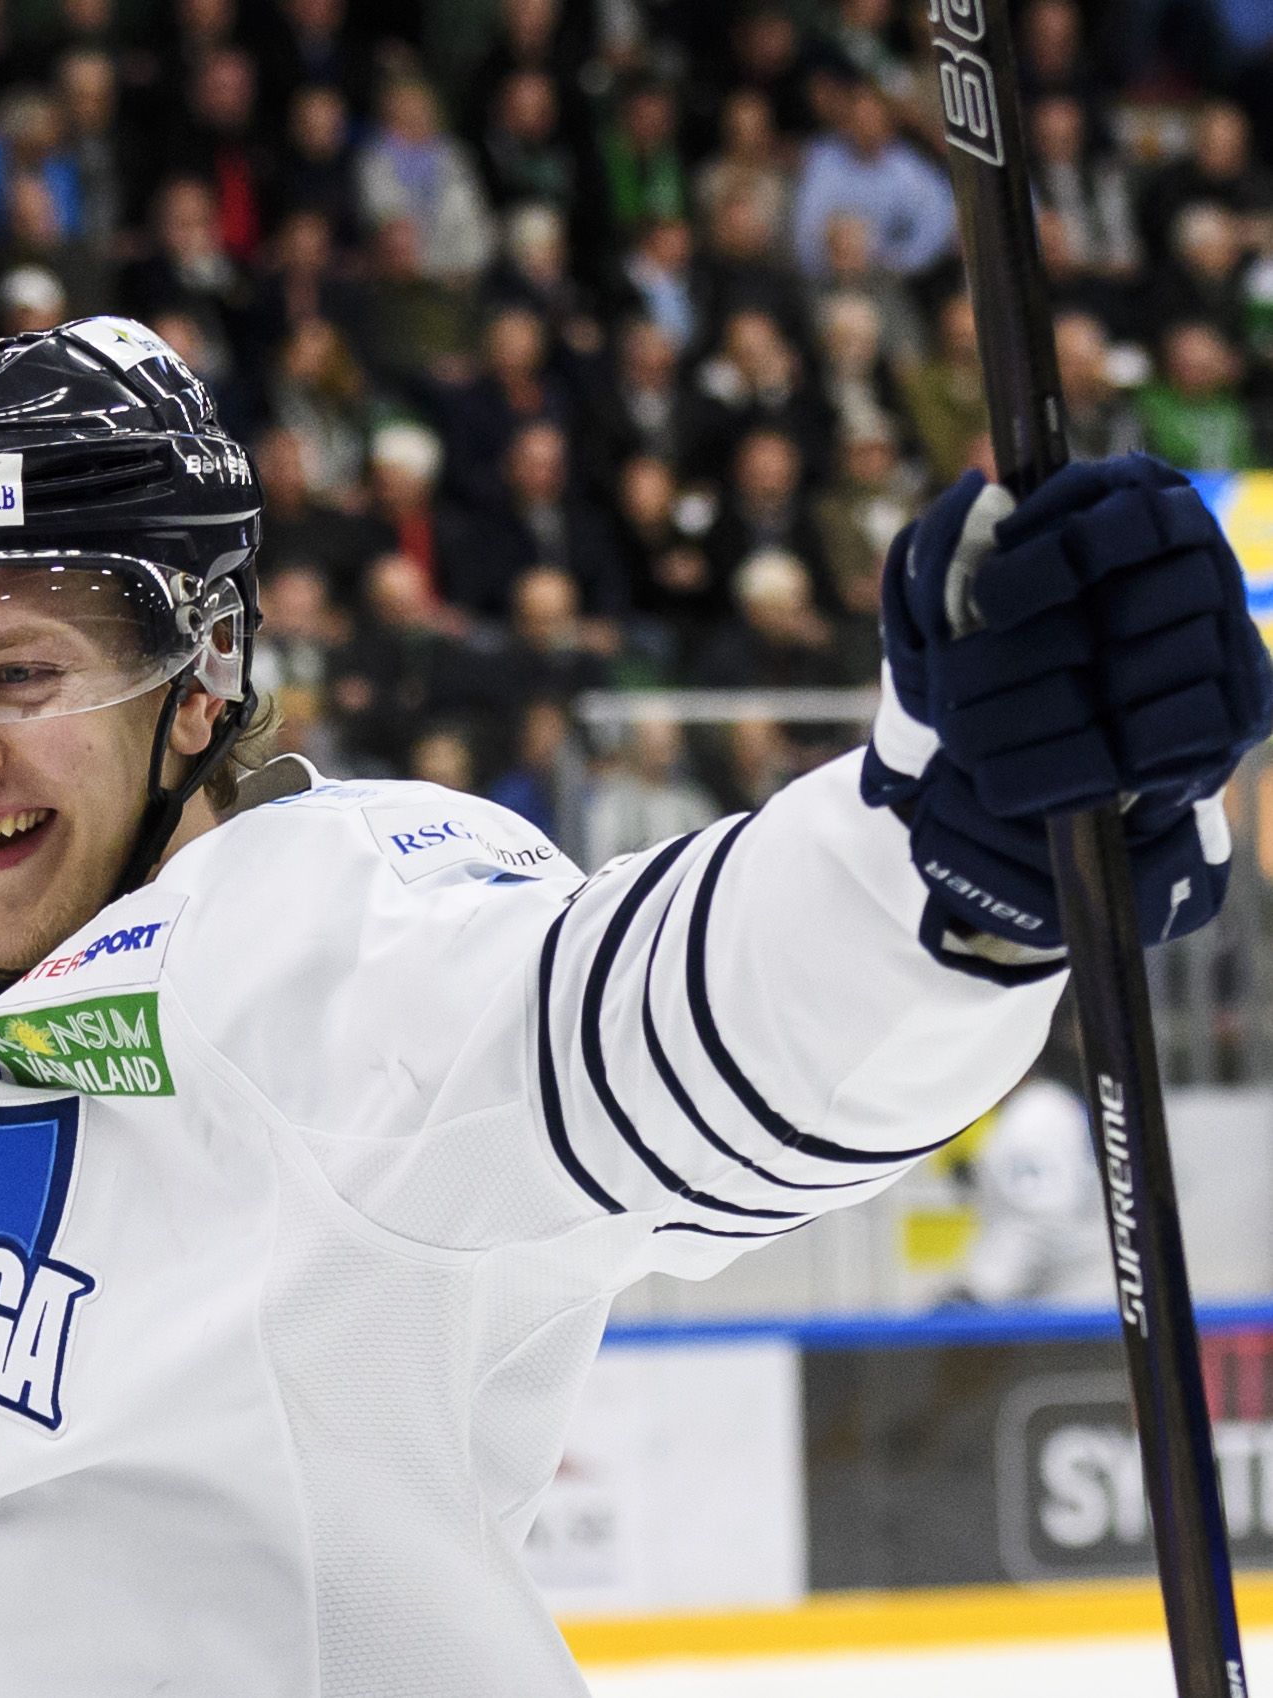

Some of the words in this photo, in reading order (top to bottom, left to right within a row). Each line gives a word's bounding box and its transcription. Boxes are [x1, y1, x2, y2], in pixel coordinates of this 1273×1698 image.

[390, 820, 472, 856] RSG
[23, 923, 162, 982] TERSPORT
[1098, 1074, 1149, 1338] SUPREME
